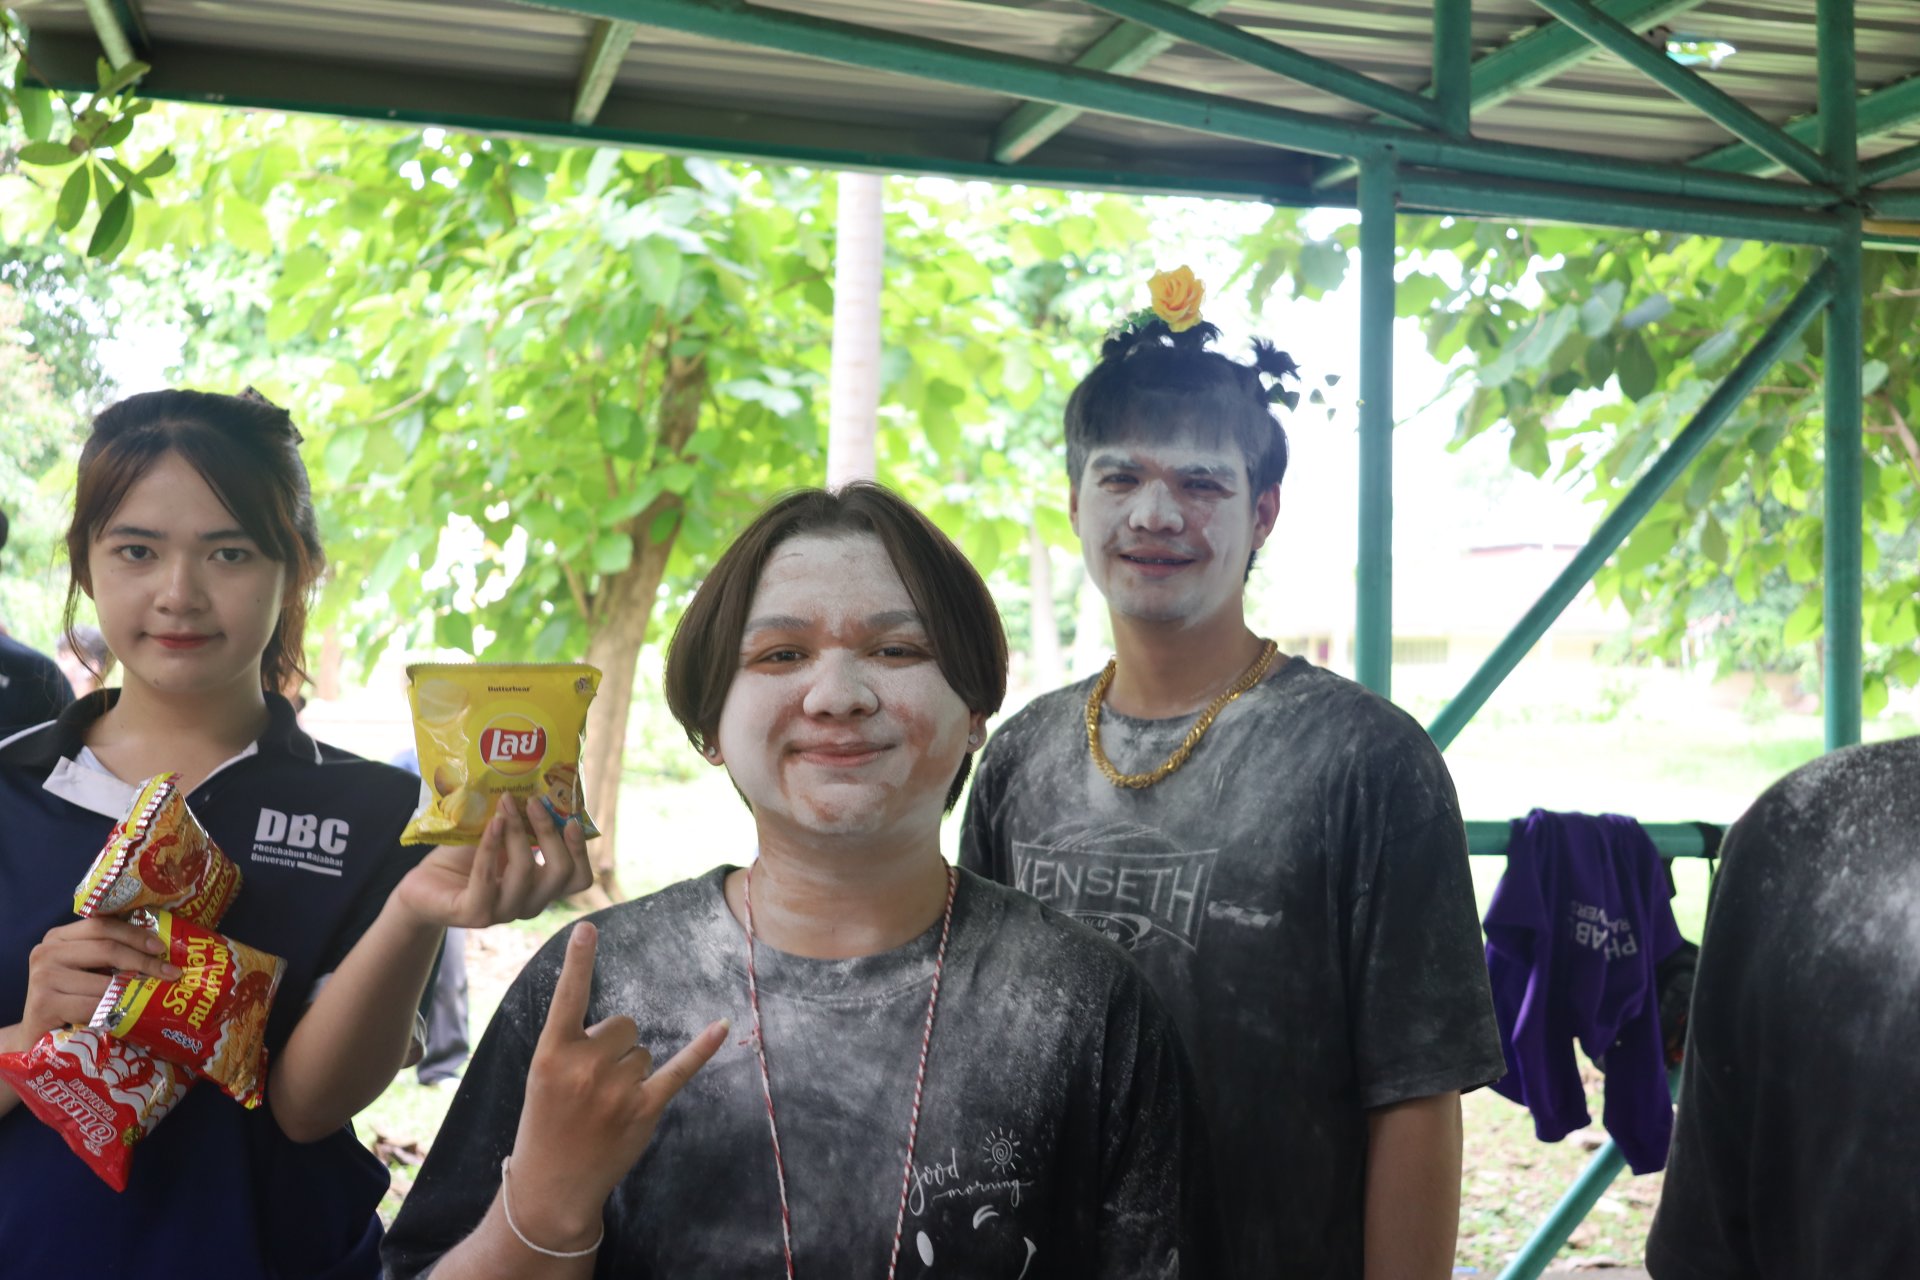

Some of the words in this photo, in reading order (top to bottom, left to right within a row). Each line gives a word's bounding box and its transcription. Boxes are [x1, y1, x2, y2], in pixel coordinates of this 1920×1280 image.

[489, 728, 538, 761] เลย์
[255, 807, 350, 855] DBC
[250, 852, 296, 869] University
[1014, 855, 1205, 937] KENSETH
[932, 1178, 1035, 1208] morning
